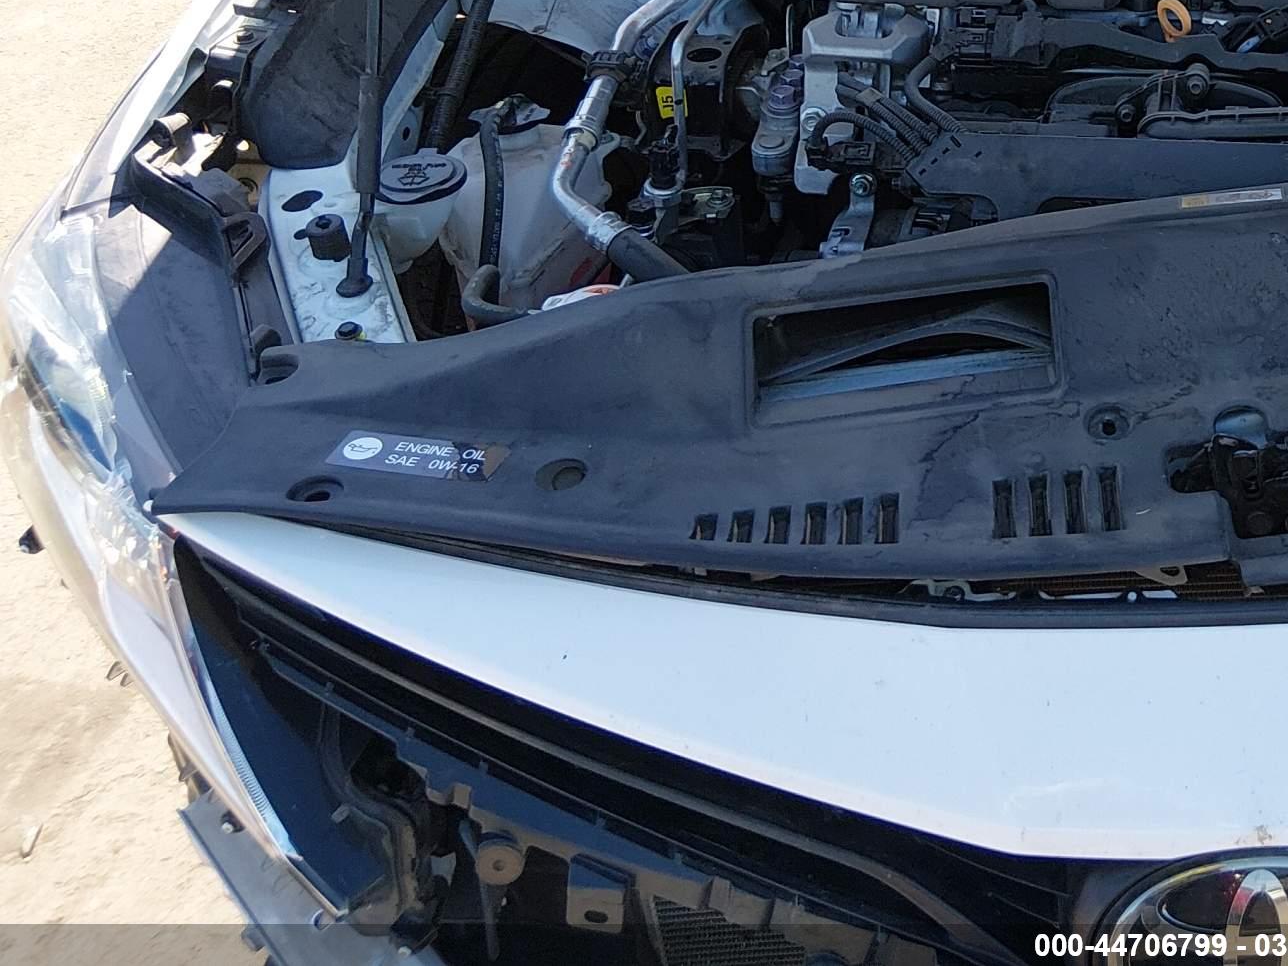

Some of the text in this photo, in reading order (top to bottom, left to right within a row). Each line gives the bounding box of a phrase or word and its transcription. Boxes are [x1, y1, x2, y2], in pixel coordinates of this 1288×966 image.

[395, 442, 487, 462] ENGINE OIL
[385, 454, 480, 474] SAE 0W-16
